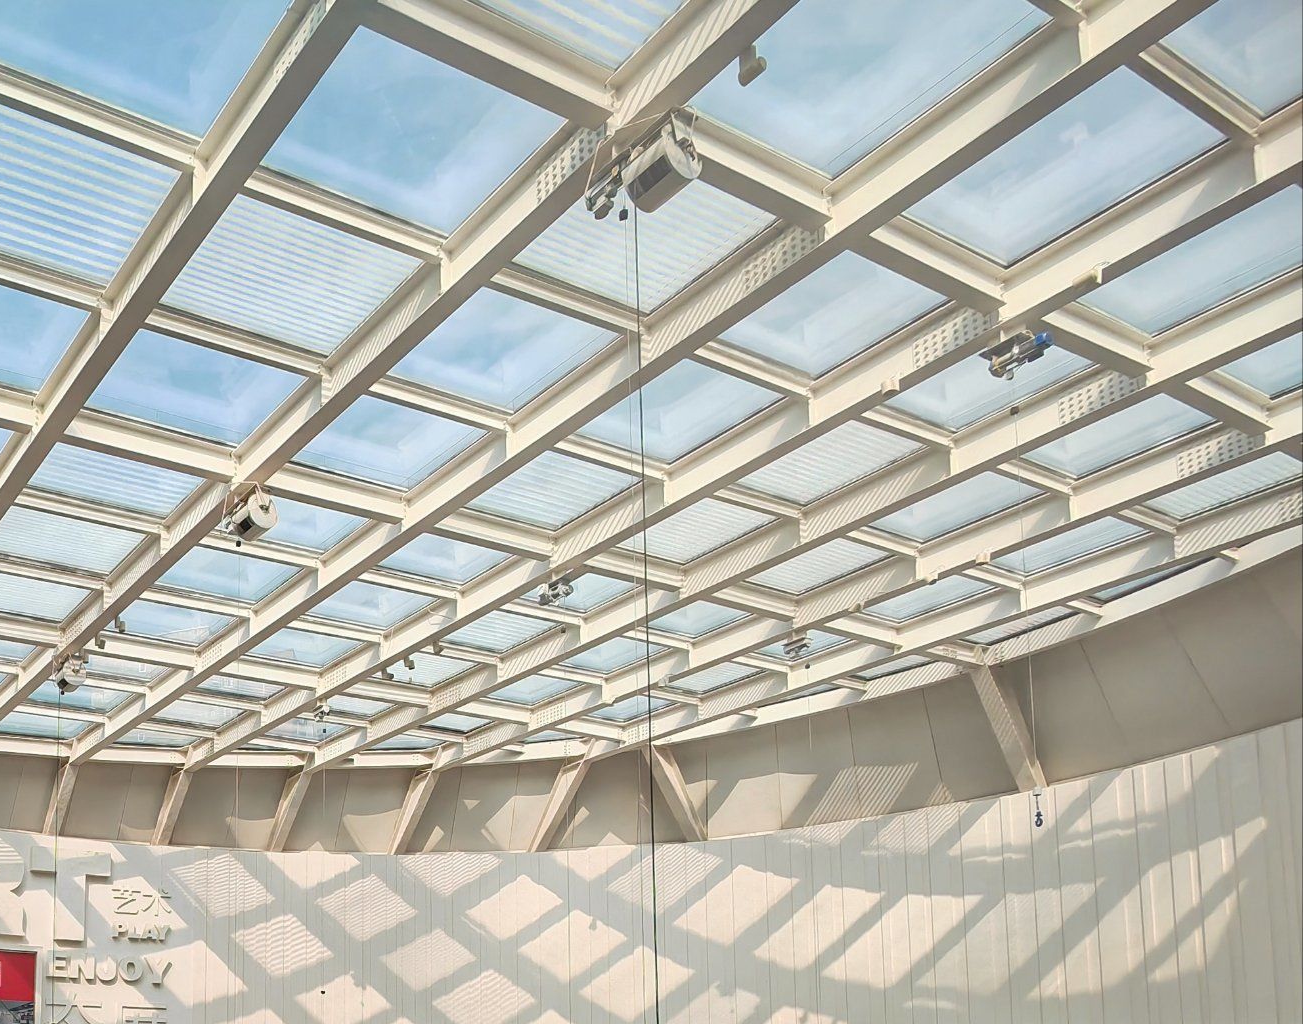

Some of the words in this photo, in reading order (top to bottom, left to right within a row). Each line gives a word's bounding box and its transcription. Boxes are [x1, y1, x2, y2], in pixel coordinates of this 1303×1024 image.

[112, 887, 172, 918] 艺术
[111, 923, 172, 942] PLAY
[47, 954, 173, 985] ENJOY
